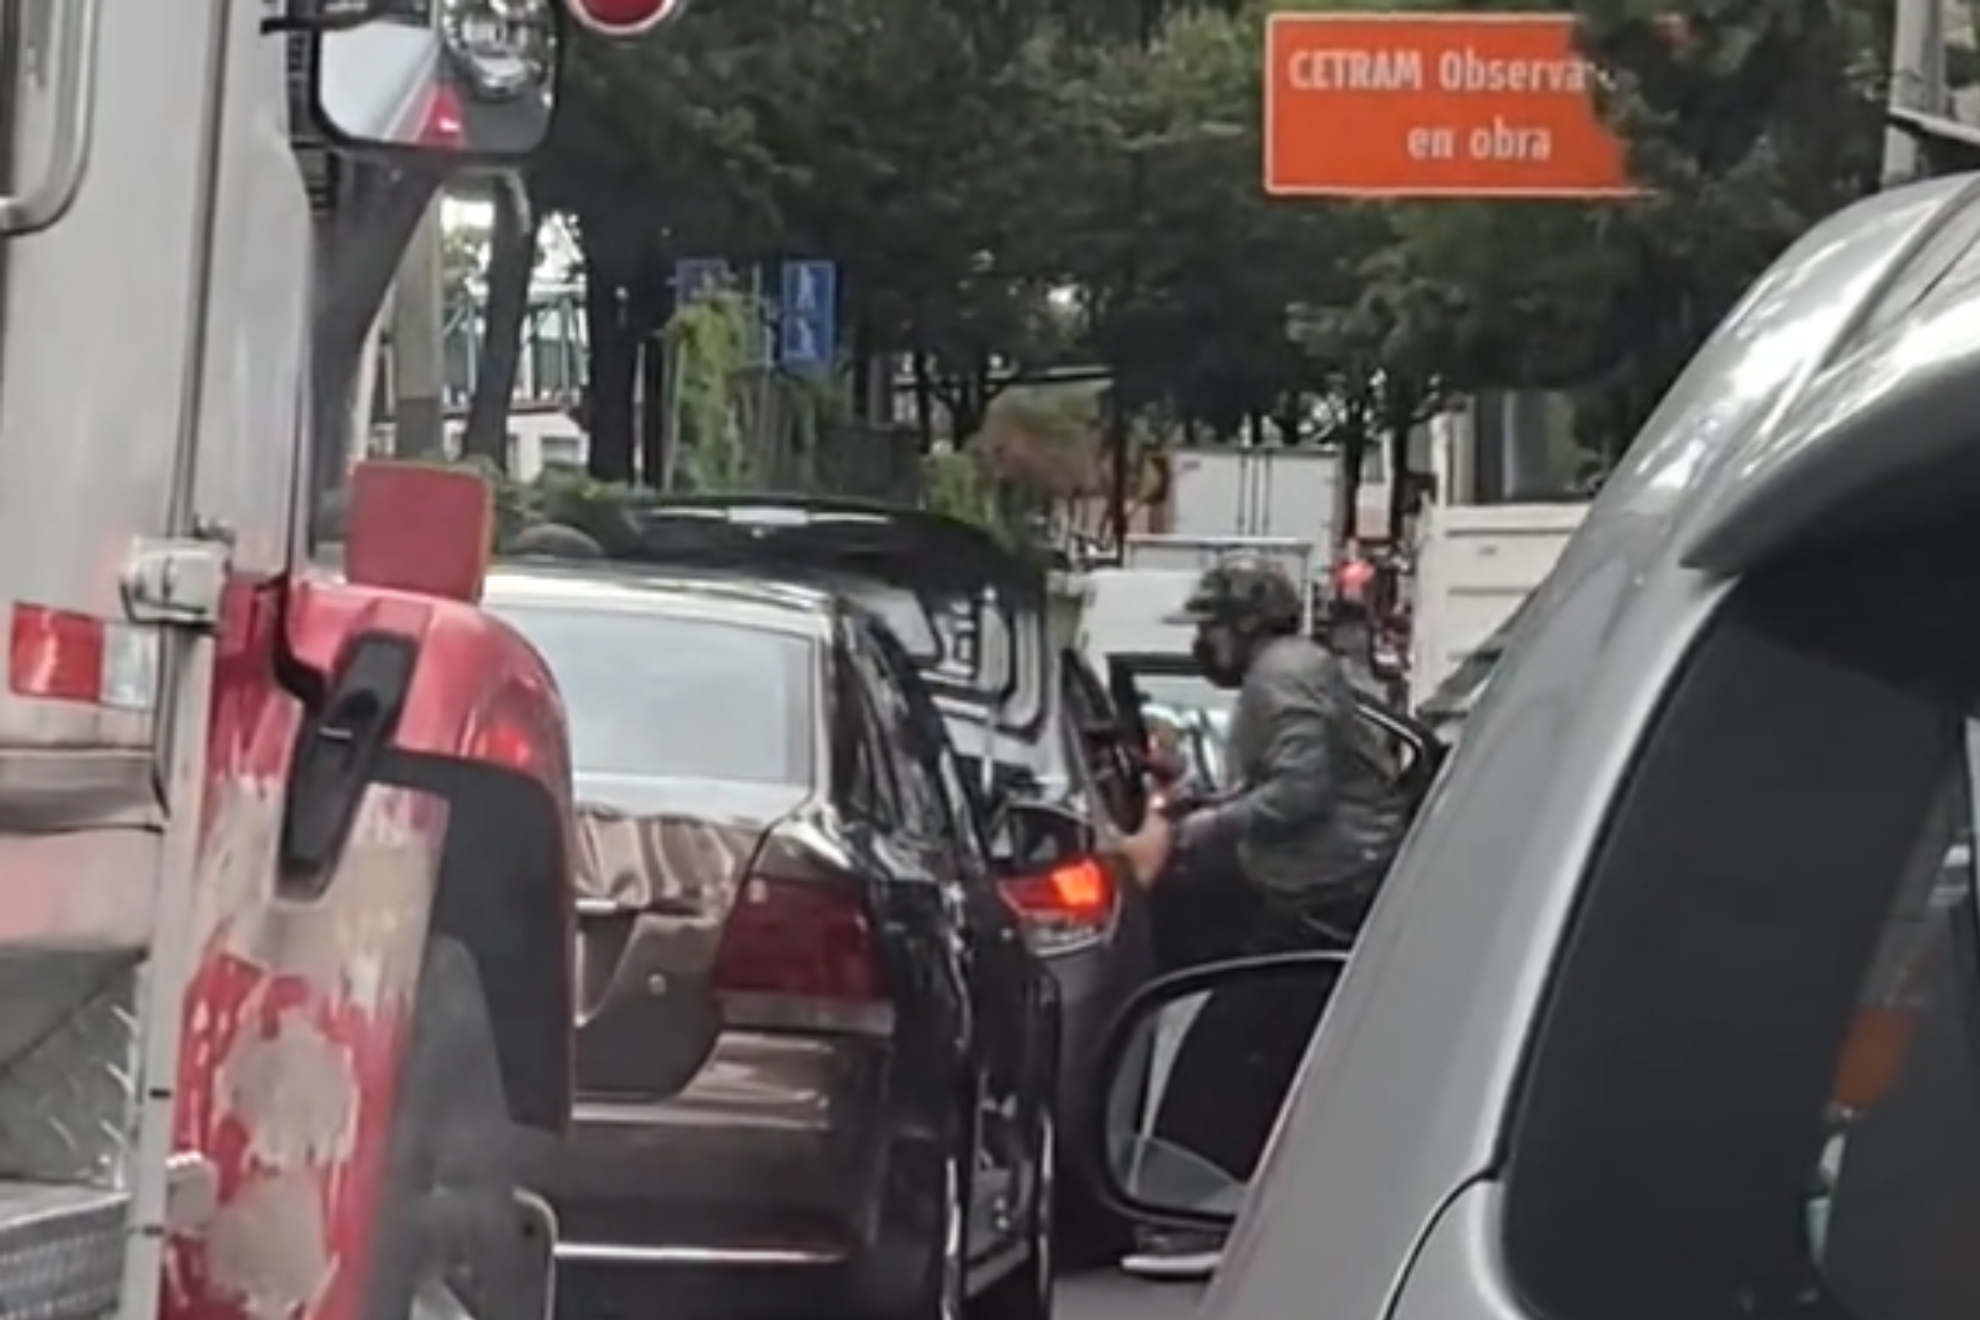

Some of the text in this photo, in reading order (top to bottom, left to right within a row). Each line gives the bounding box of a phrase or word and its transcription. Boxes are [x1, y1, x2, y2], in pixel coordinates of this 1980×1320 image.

[1288, 48, 1594, 91] CETRAM Observa
[1407, 116, 1551, 160] en obra
